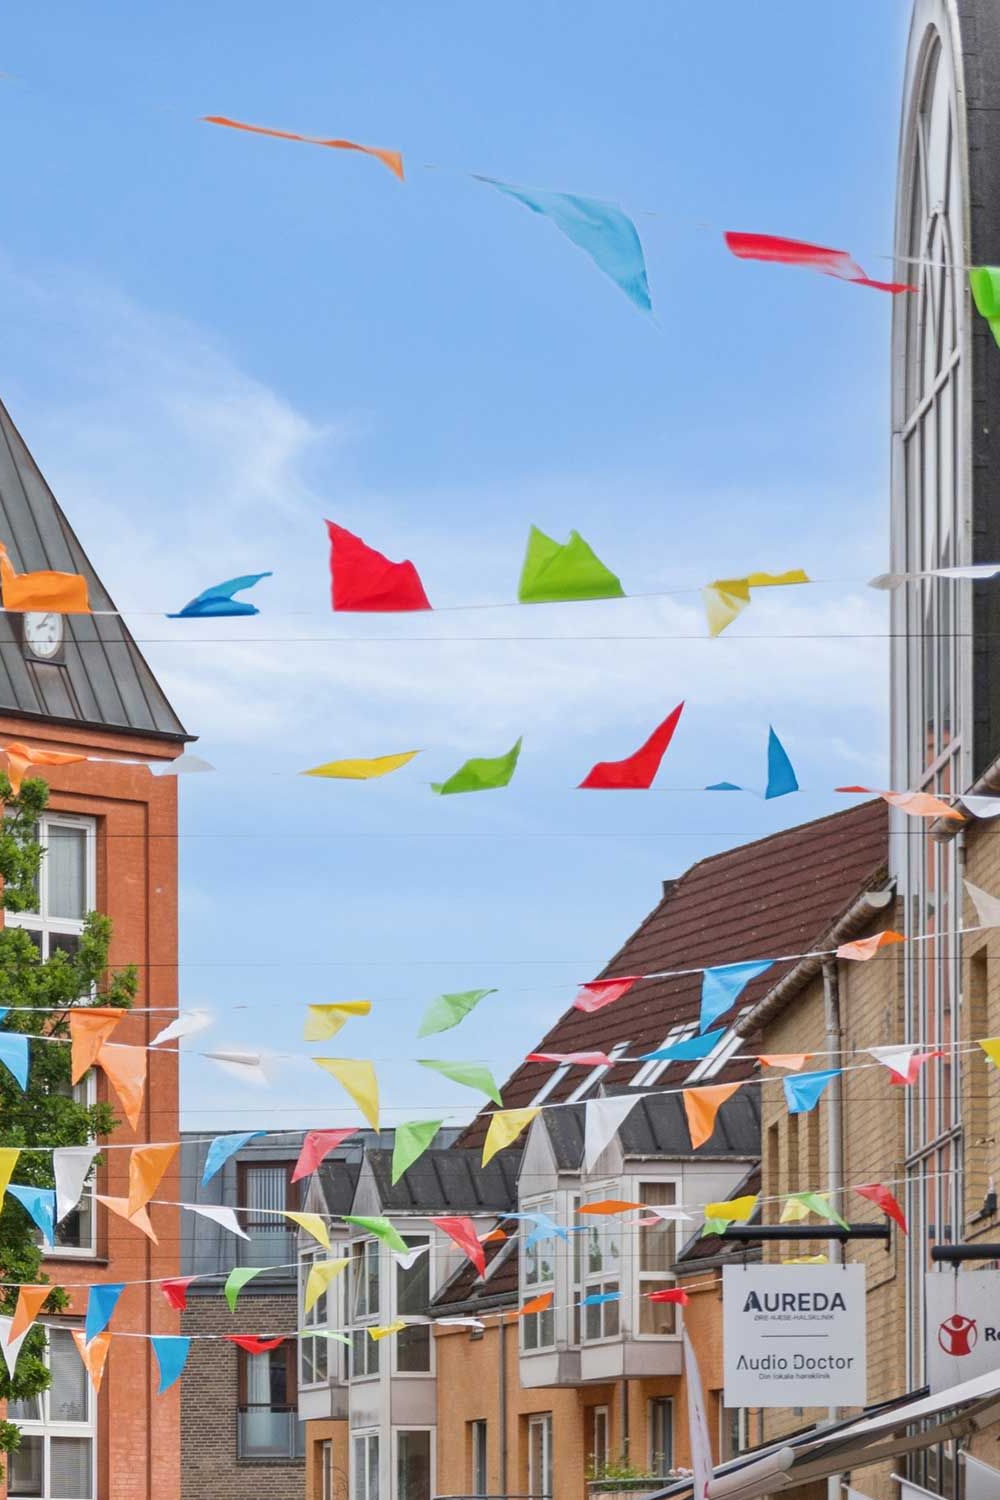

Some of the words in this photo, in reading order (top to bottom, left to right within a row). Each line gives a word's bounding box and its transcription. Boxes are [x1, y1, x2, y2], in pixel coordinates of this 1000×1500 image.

[742, 1290, 847, 1312] AUREDA
[736, 1354, 788, 1370] Audio
[793, 1354, 854, 1370] Doctor
